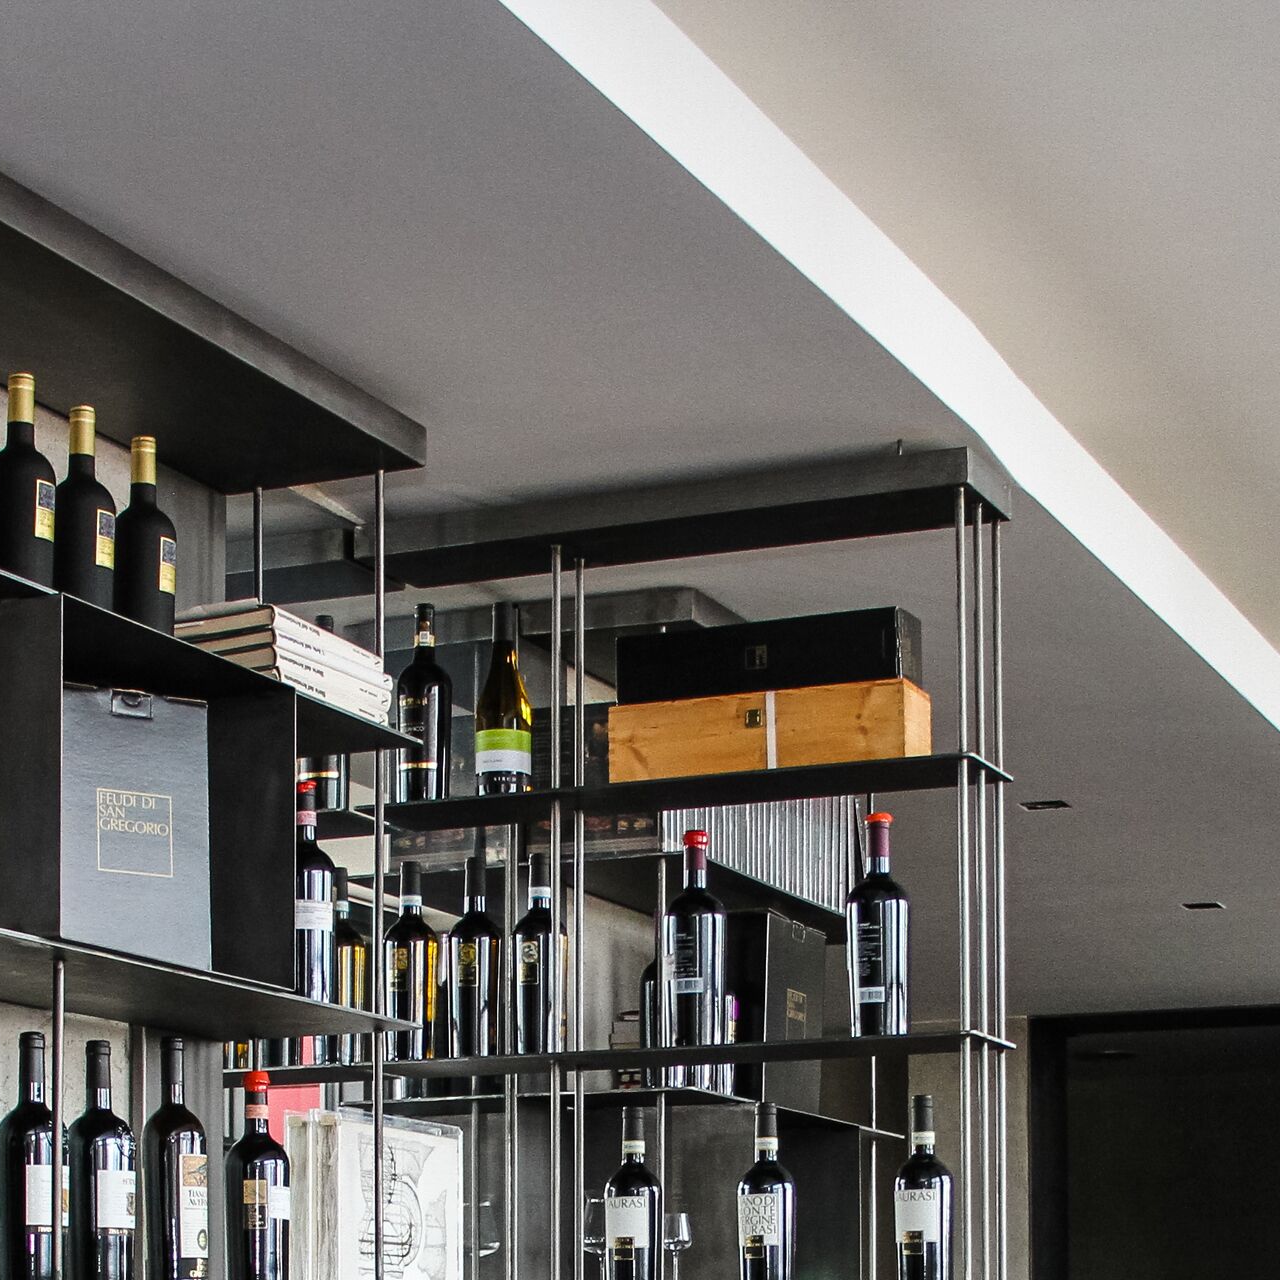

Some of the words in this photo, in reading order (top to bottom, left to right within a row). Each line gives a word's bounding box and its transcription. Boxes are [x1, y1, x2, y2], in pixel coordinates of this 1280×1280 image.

[99, 791, 136, 808] FEUDI
[141, 796, 155, 810] DI
[99, 804, 126, 818] SAN
[100, 816, 169, 836] GREGORIO
[896, 1191, 936, 1202] AURASI
[608, 1198, 646, 1208] AURASI
[744, 1206, 775, 1215] ONTE
[742, 1216, 775, 1225] ERGINE
[742, 1225, 776, 1234] AURASI
